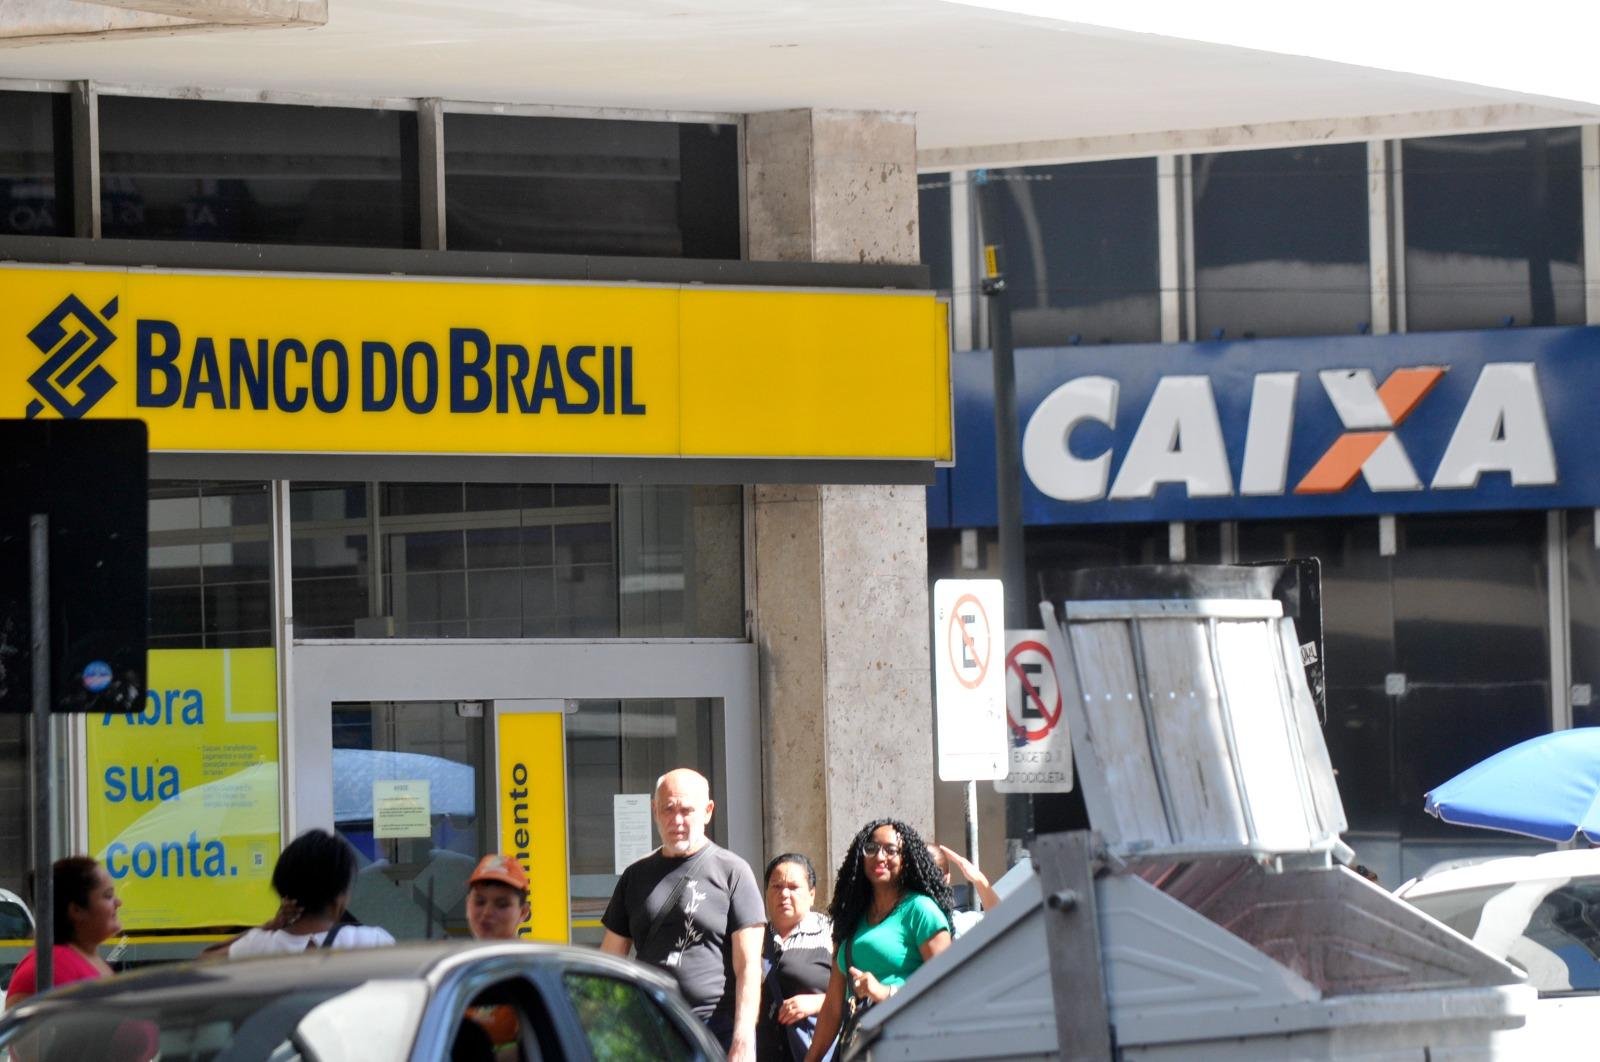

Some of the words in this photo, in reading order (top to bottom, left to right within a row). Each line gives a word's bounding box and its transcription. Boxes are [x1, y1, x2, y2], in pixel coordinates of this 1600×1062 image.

[136, 319, 350, 414] BANCO
[361, 340, 439, 415] DO
[450, 328, 646, 416] BRASIL
[1022, 361, 1558, 502] CAIXA
[104, 764, 180, 803] sua
[1001, 771, 1067, 784] OTOCICLETA
[105, 832, 238, 880] conta.
